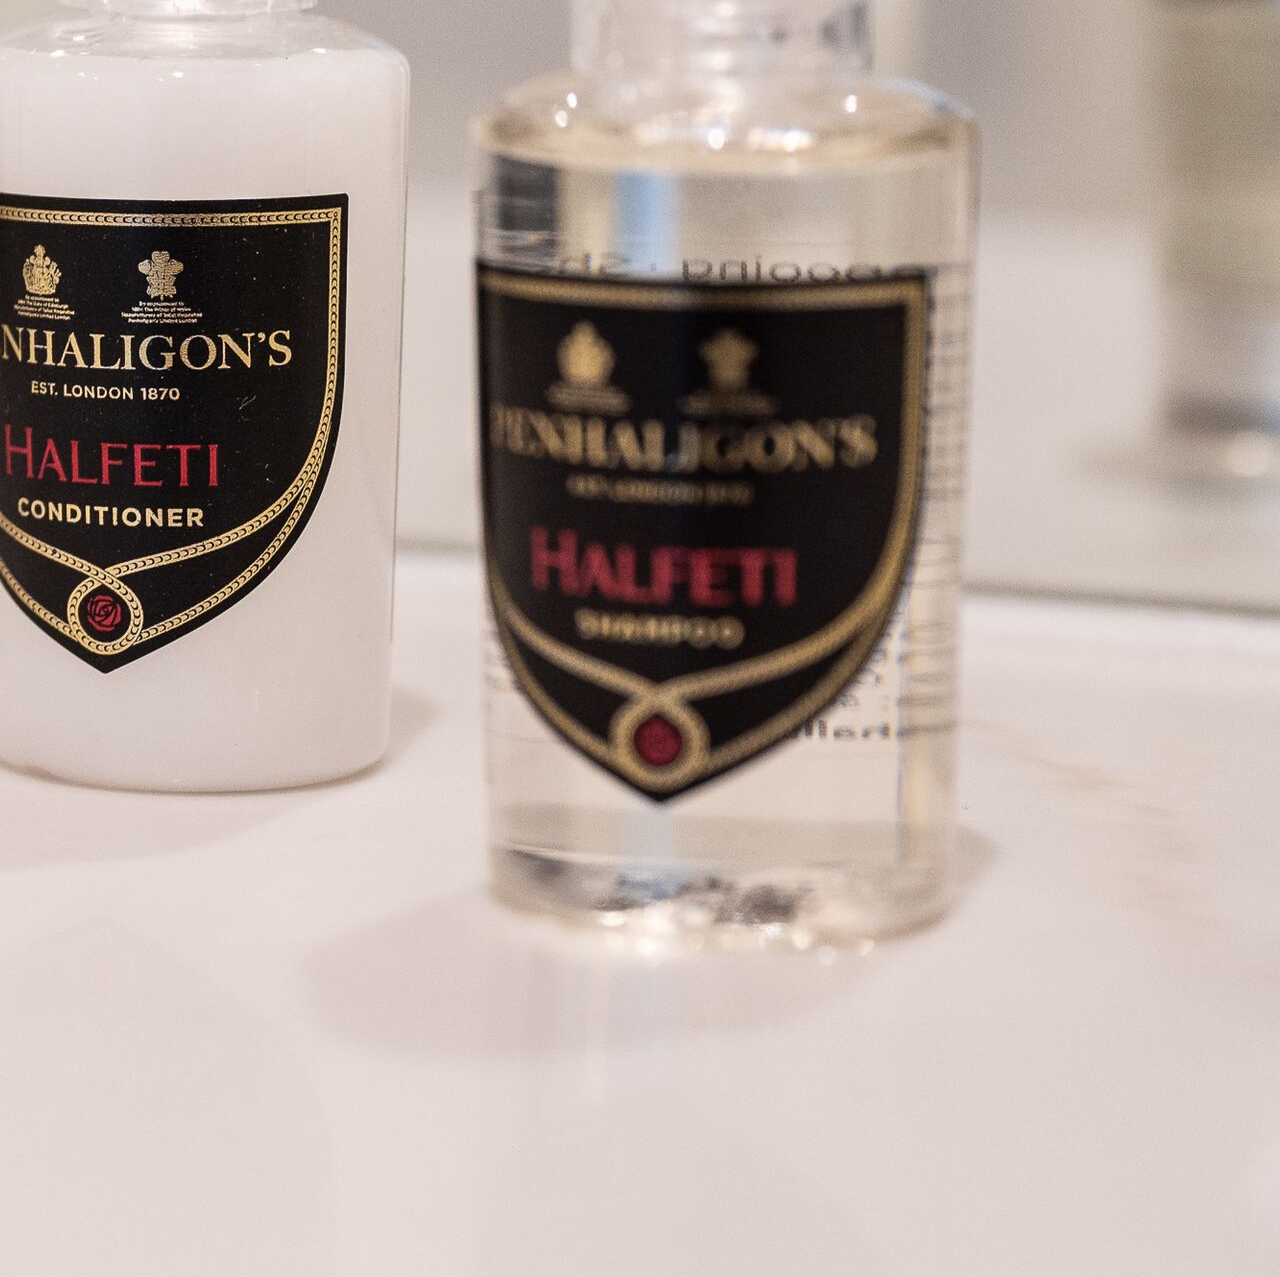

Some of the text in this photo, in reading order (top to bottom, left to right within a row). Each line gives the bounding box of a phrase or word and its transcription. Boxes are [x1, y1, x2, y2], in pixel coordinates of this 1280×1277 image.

[31, 380, 180, 401] EST. LONDON 1870
[5, 423, 218, 487] HALFETI
[17, 496, 204, 528] CONDITIONER
[531, 526, 797, 607] HALFETI
